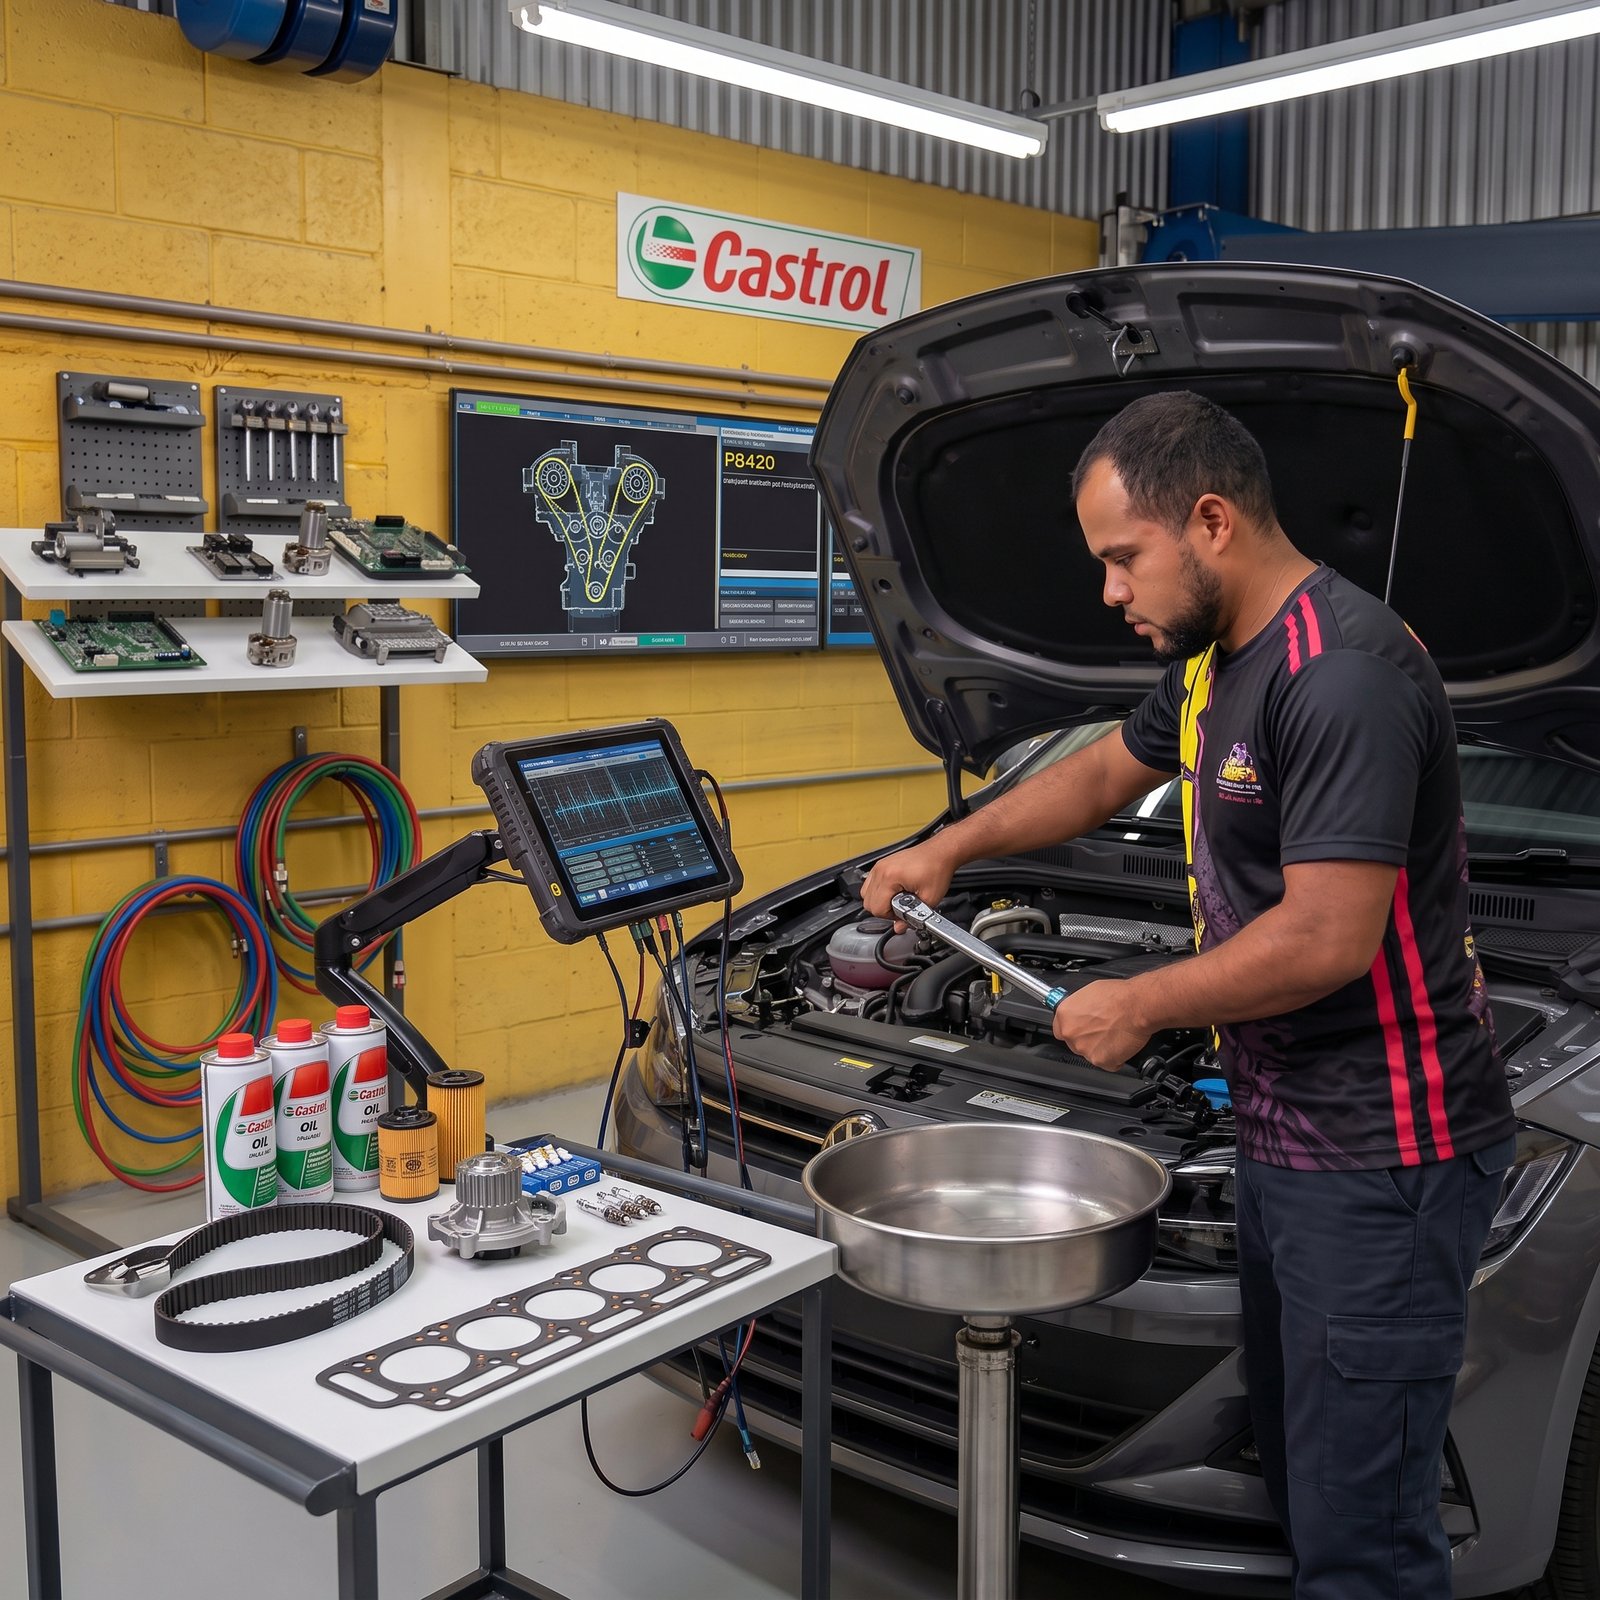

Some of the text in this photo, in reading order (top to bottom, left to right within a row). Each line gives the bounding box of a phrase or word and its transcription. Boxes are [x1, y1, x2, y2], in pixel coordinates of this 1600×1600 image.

[703, 230, 890, 315] Castrol
[724, 452, 775, 470] P8420
[364, 1103, 380, 1116] OIL
[300, 1120, 318, 1132] OIL
[252, 1136, 269, 1149] OIL
